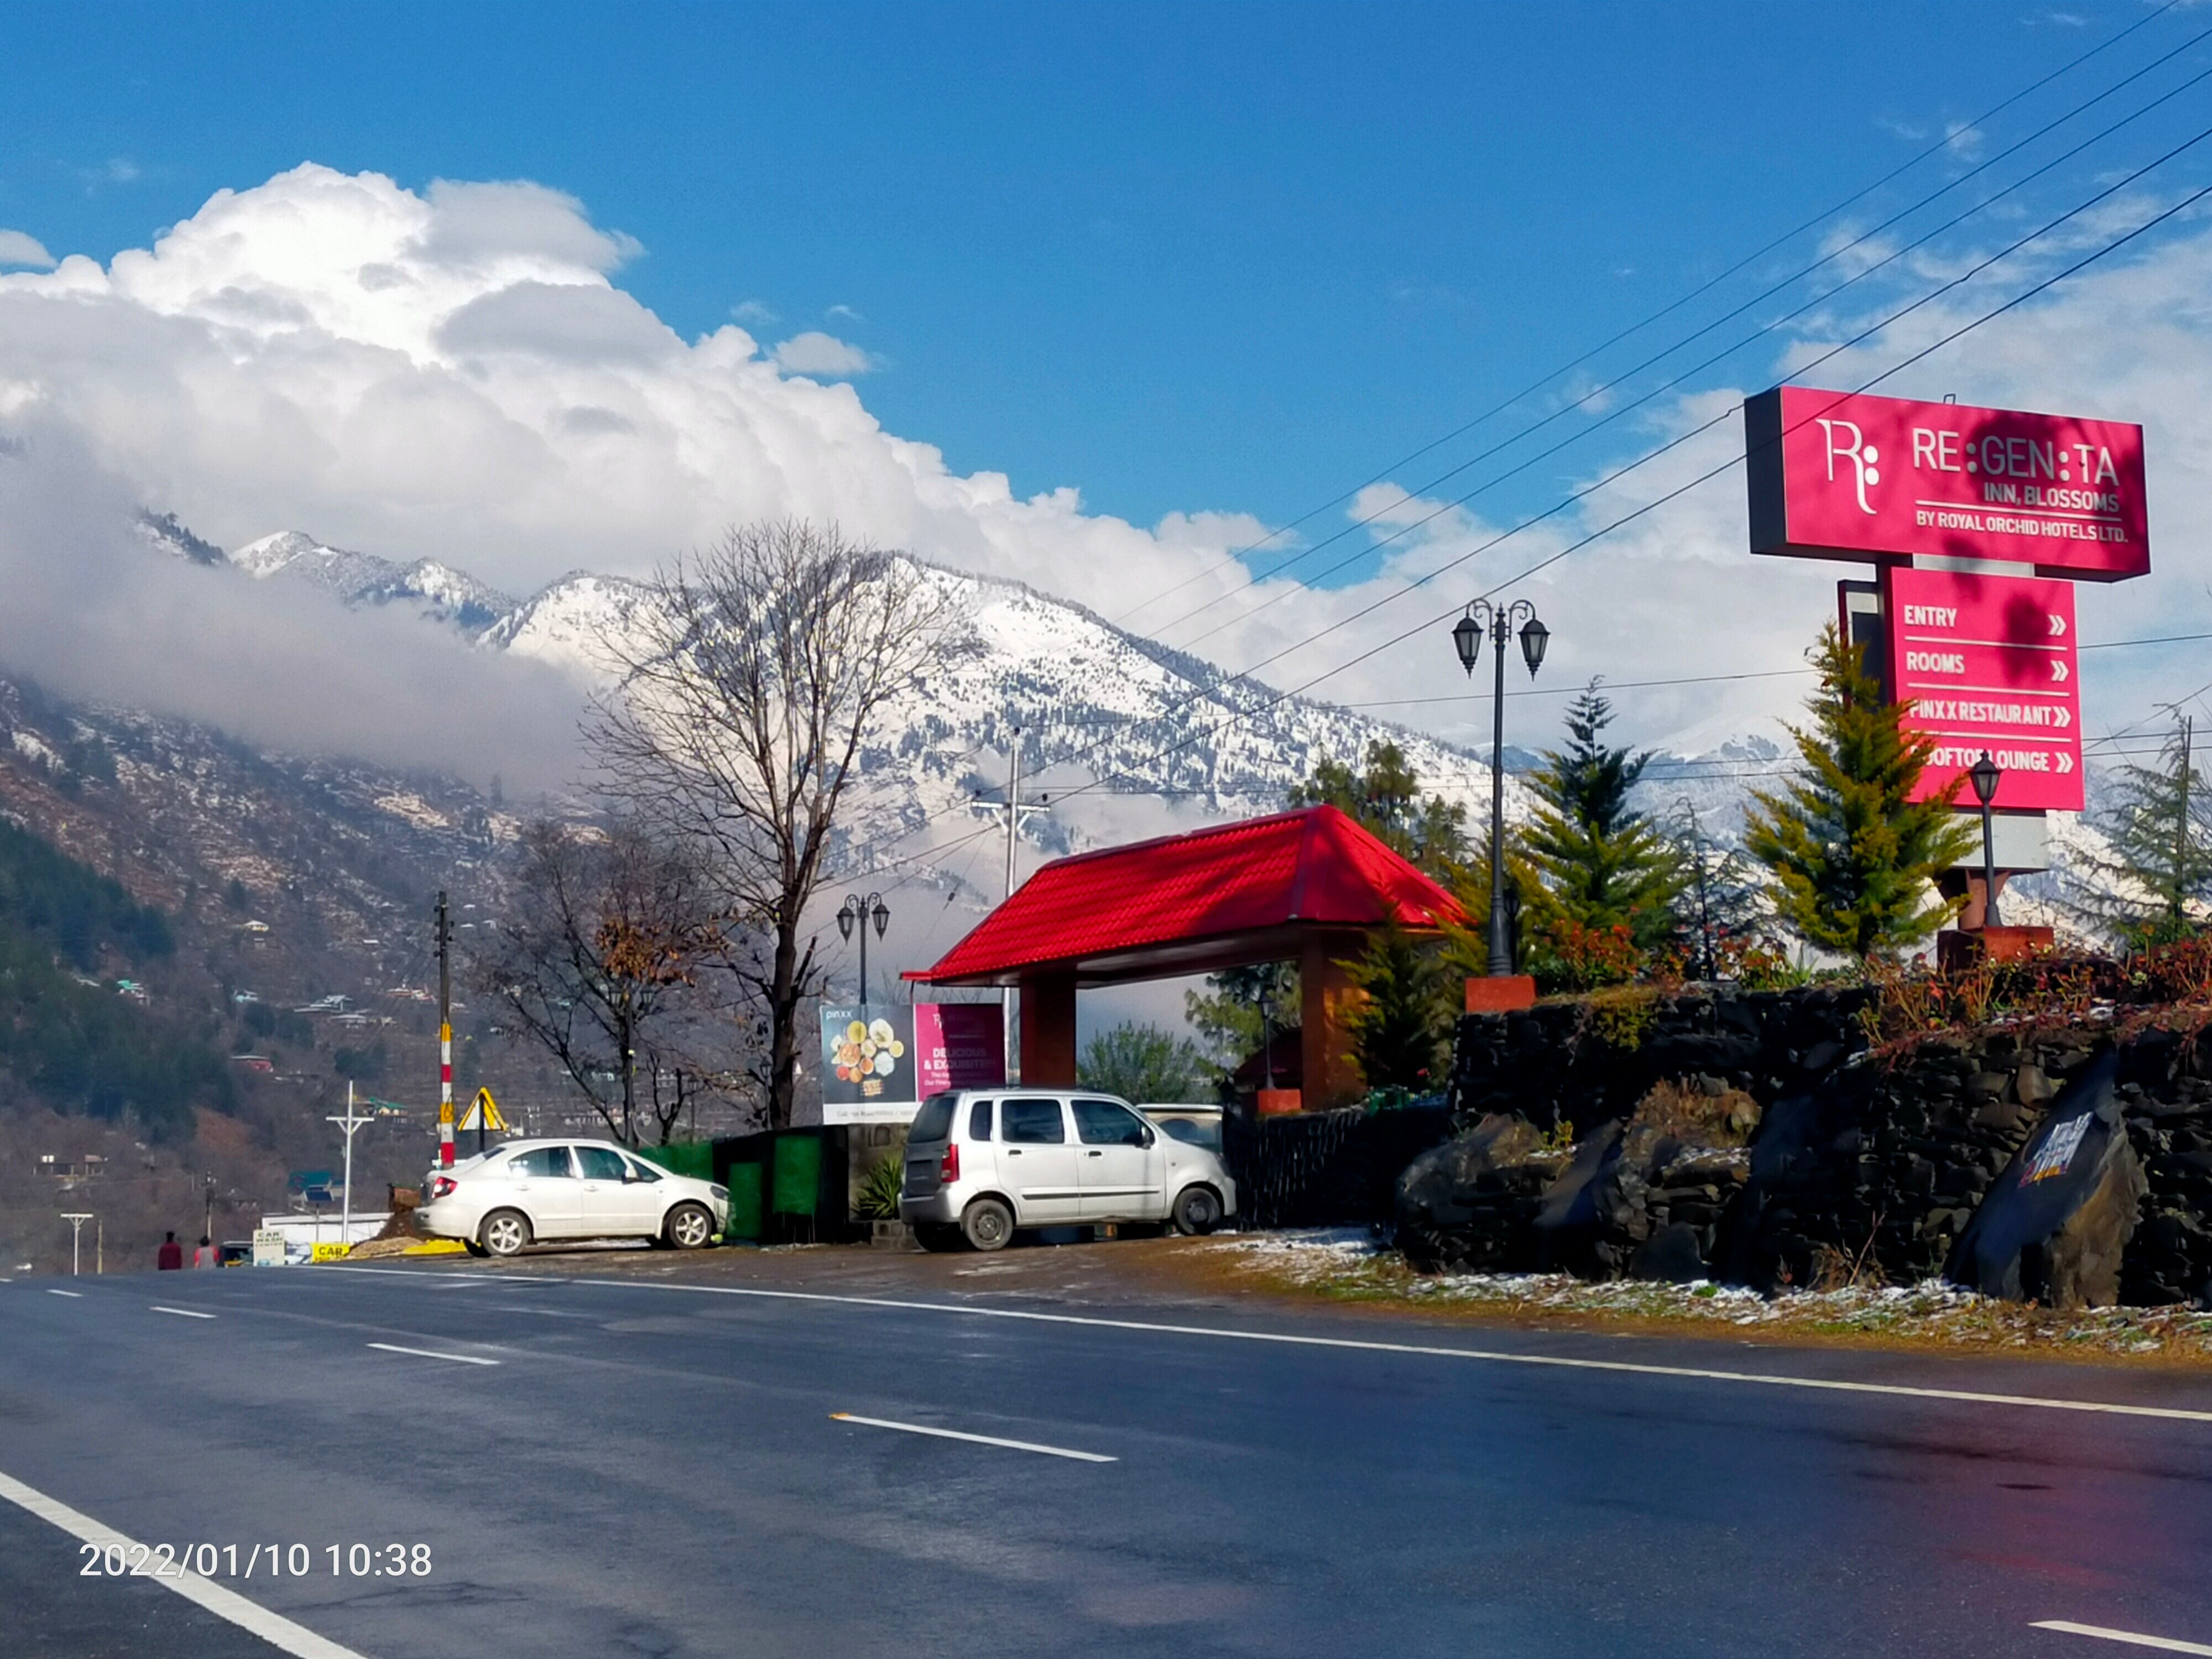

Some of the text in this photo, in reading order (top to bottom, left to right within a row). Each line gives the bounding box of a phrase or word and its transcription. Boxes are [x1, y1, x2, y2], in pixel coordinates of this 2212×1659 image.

[1984, 482, 2120, 513] INN, BLOSSOMS
[1916, 510, 2128, 543] BY ROYAL ORCHID HOTELS LTD.
[1904, 604, 1957, 628] ENTRY
[1906, 651, 1965, 674] ROOMS
[1959, 701, 2052, 726] RESTAURANT
[319, 1246, 343, 1256] CAR
